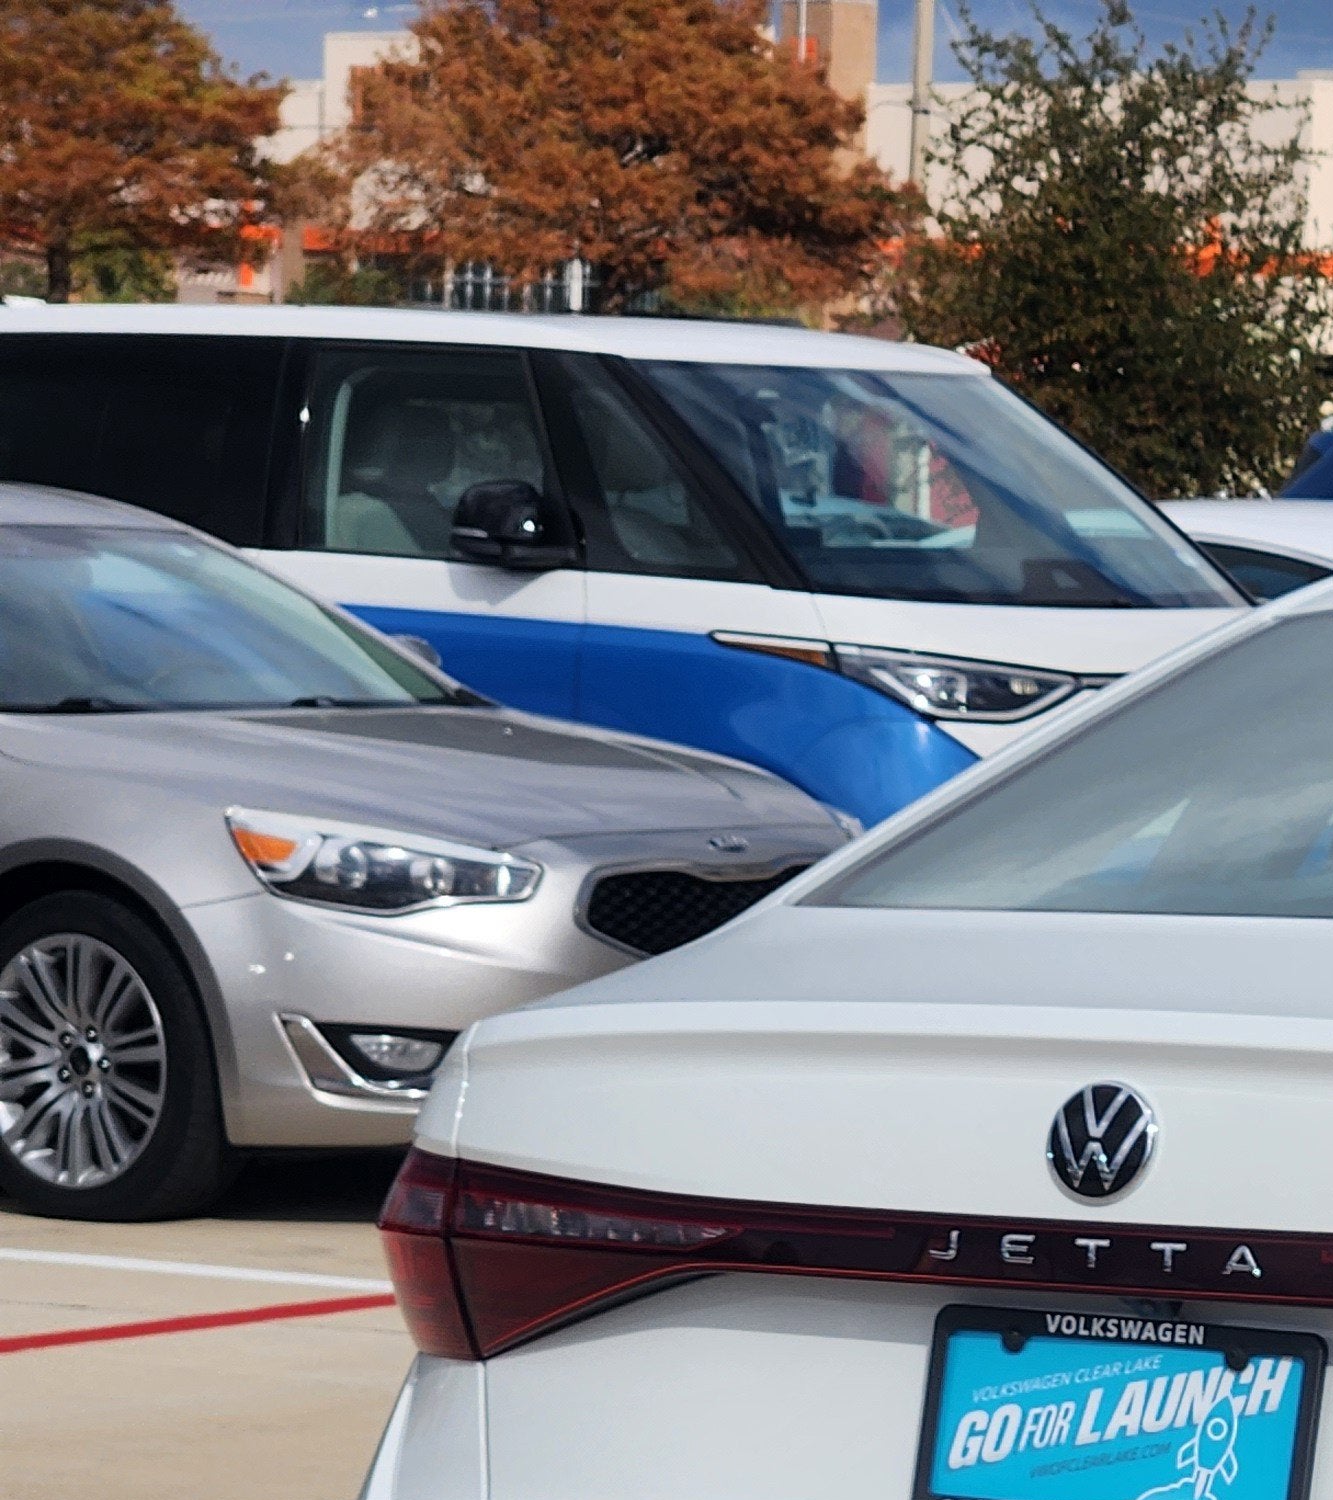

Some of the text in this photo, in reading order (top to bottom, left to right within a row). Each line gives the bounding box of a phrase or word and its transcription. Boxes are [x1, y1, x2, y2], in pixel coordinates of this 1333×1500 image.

[929, 1230, 1262, 1278] JETTA
[1046, 1314, 1205, 1345] VOLKSWAGEN
[972, 1354, 1164, 1403] VOLKSWAGEN CLEAR LAKE
[948, 1356, 1294, 1470] GO FOR LAUNCH
